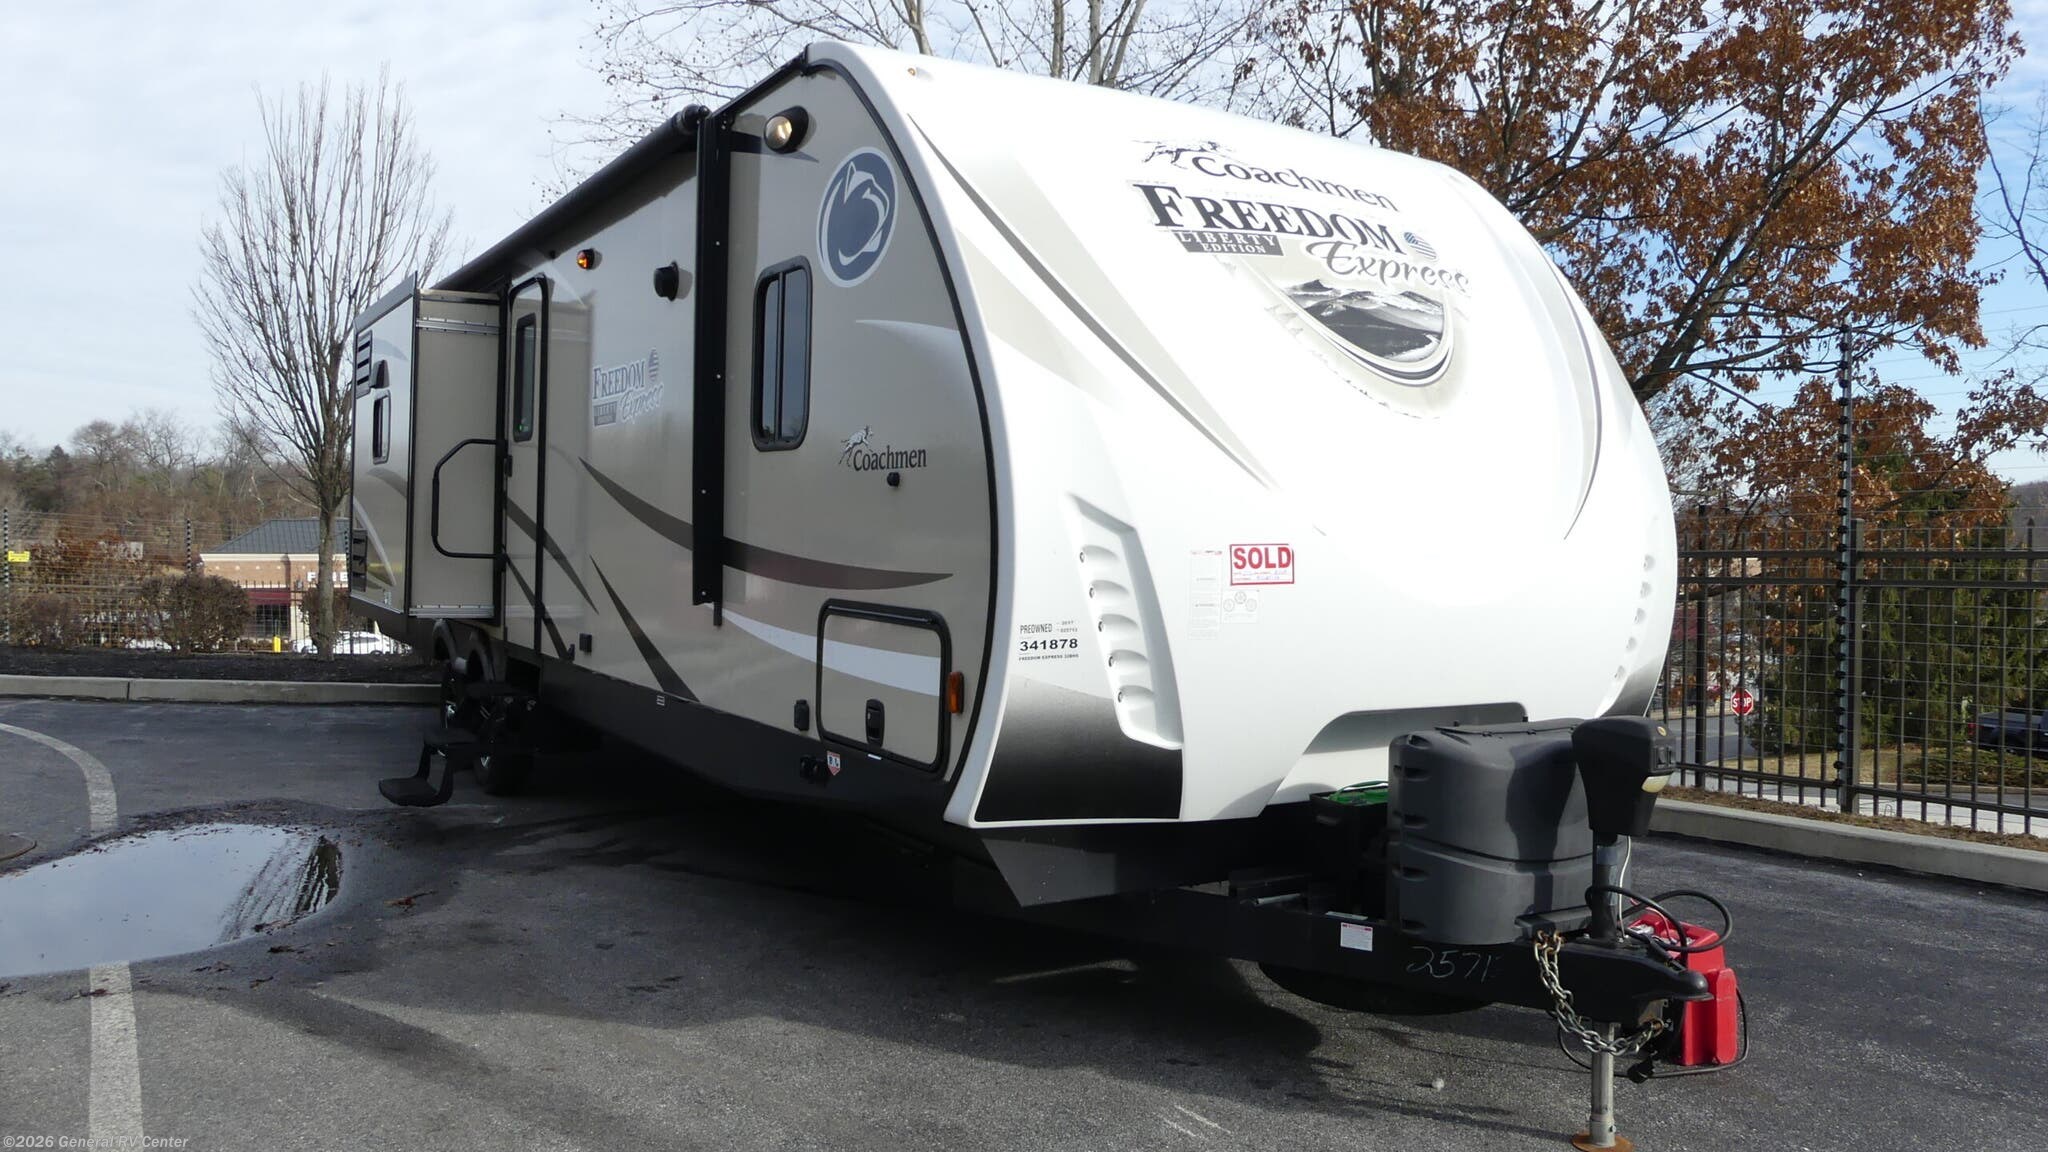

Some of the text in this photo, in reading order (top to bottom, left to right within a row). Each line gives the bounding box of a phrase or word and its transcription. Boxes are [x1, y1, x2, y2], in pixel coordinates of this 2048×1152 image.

[1191, 155, 1400, 213] Coachmen
[1133, 183, 1406, 255] FREEDOM
[1177, 231, 1277, 247] LIBERTY
[1201, 242, 1266, 254] EDITION
[1305, 240, 1471, 294] Express
[593, 360, 645, 399] FREEDOM
[853, 444, 927, 471] Coachmen
[1233, 546, 1292, 569] SOLD
[1020, 638, 1078, 651] 341878
